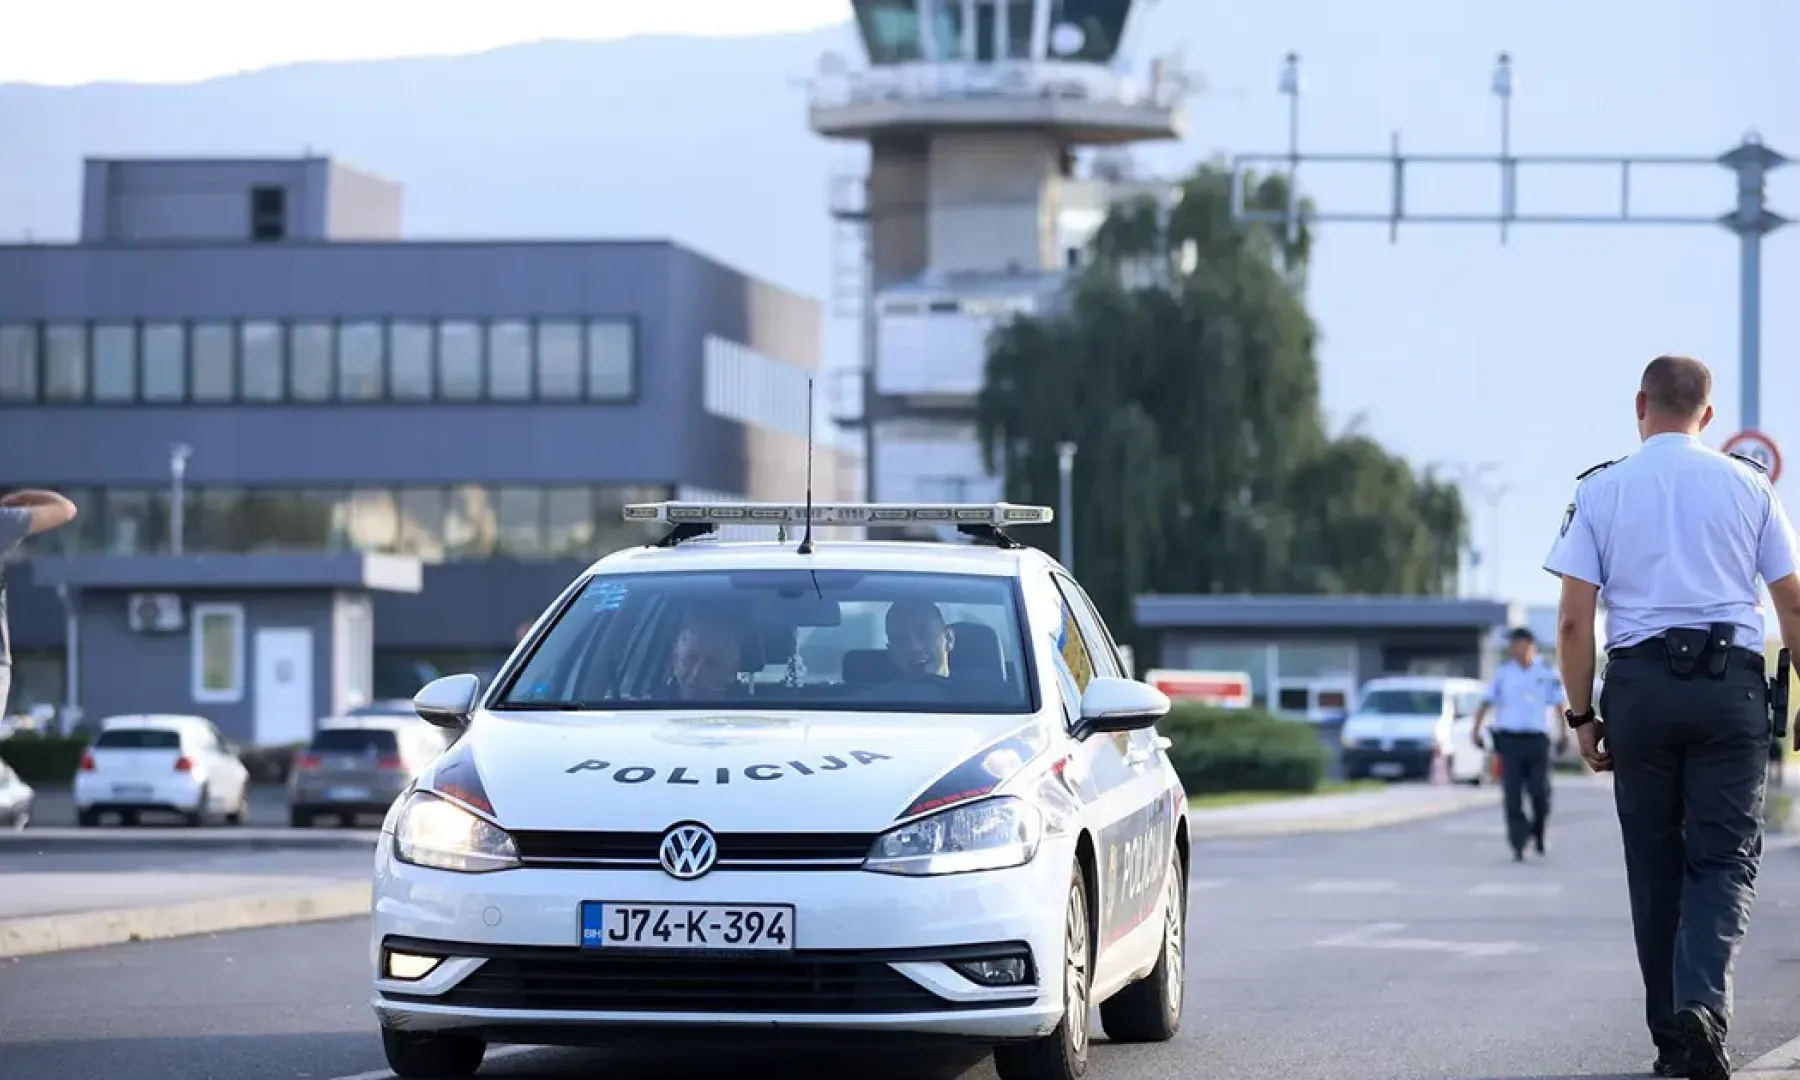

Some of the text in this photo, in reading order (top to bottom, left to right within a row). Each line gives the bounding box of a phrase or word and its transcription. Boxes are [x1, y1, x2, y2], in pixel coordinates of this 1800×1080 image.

[565, 750, 892, 785] POLICIJA
[660, 825, 716, 877] VW
[584, 928, 602, 939] BIH
[609, 908, 786, 945] J74-K-394
